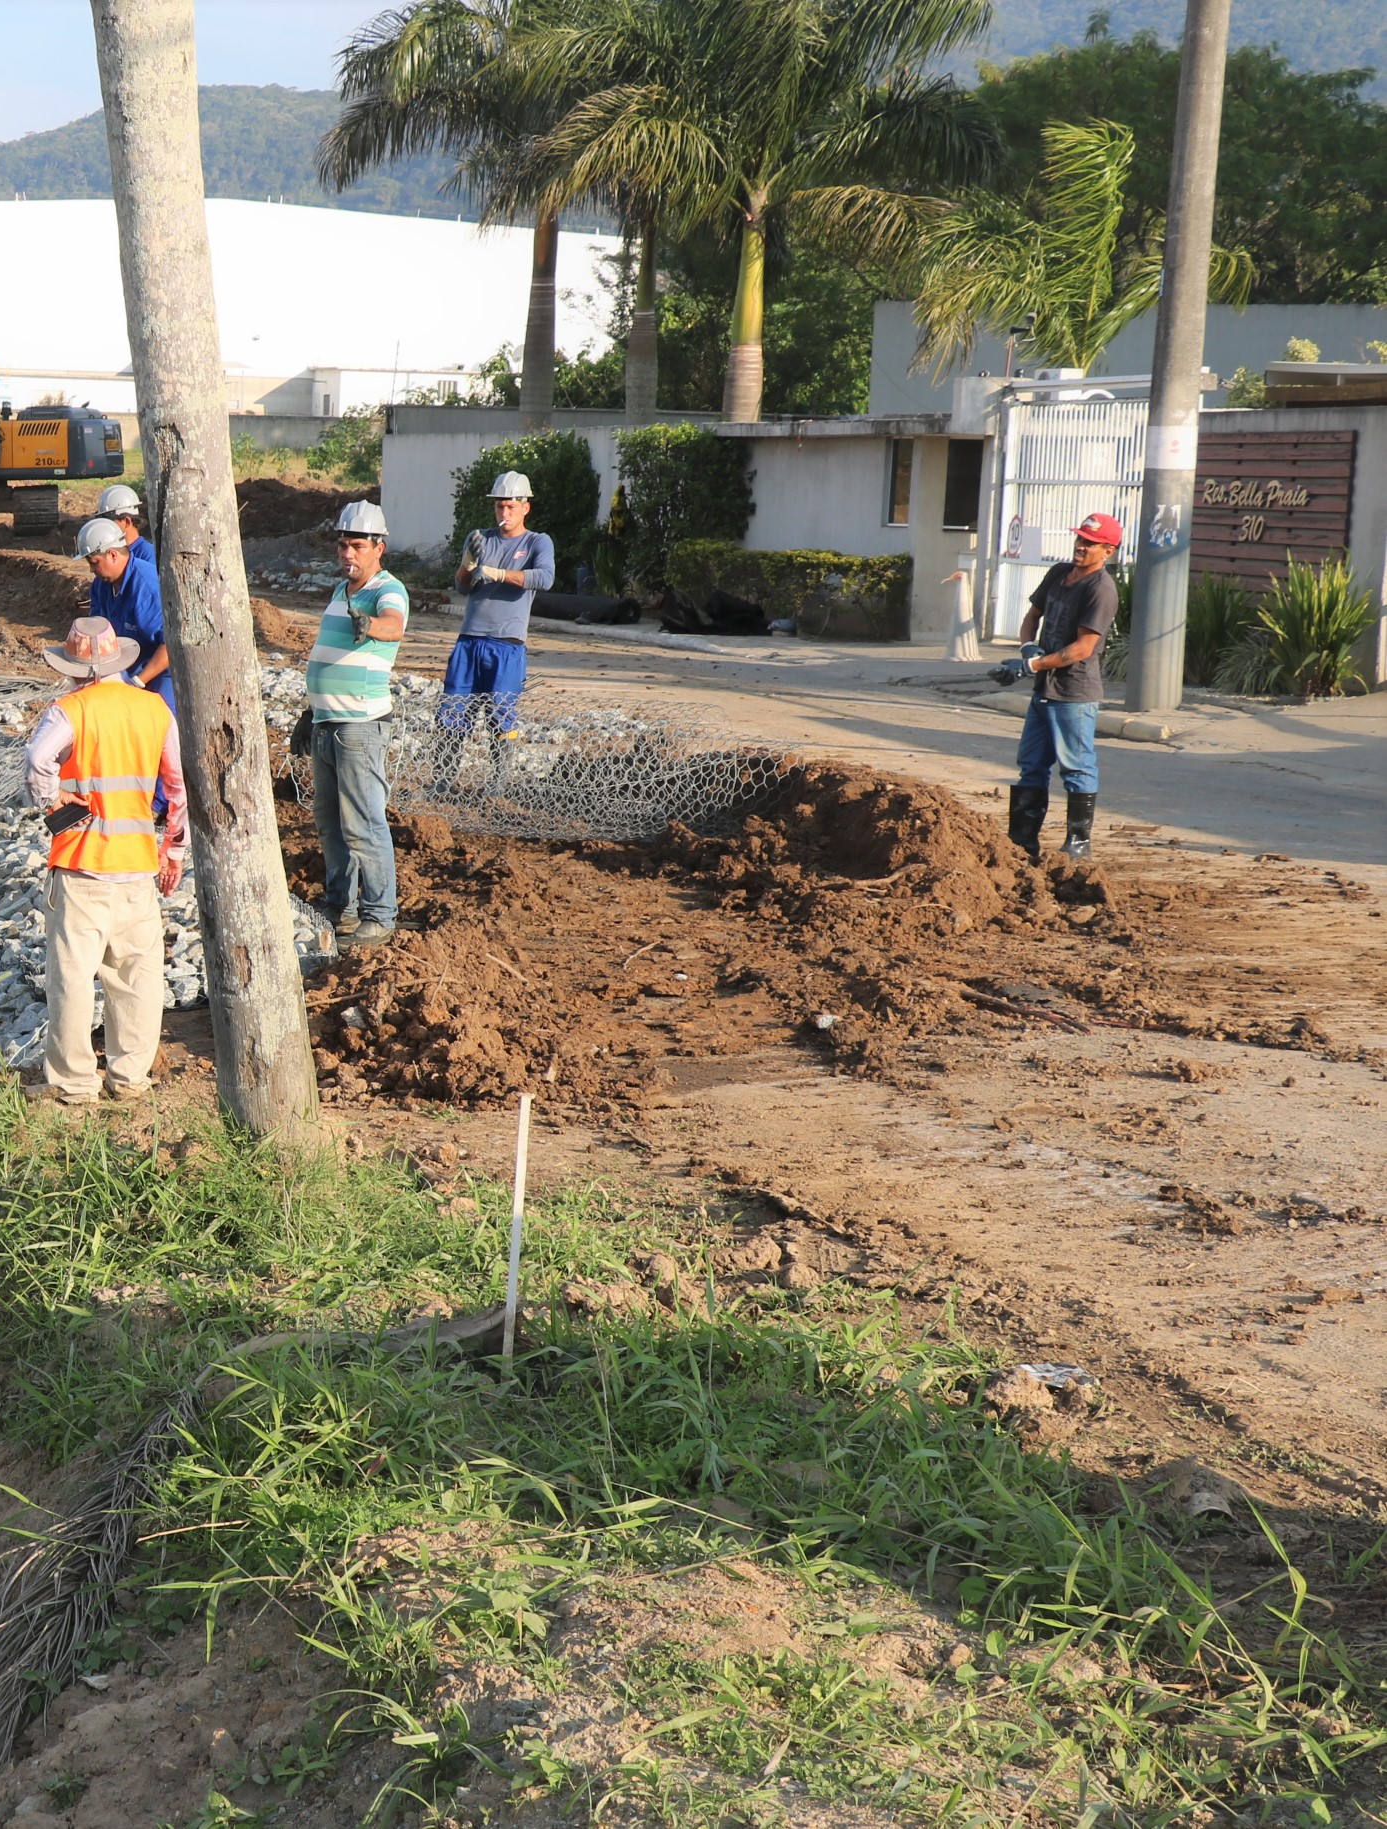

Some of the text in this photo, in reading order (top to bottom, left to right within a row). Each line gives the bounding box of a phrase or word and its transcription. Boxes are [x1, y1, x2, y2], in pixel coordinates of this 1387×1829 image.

[1202, 479, 1310, 508] Res. Bella Praia
[1011, 523, 1020, 541] 10
[1238, 515, 1265, 542] 310
